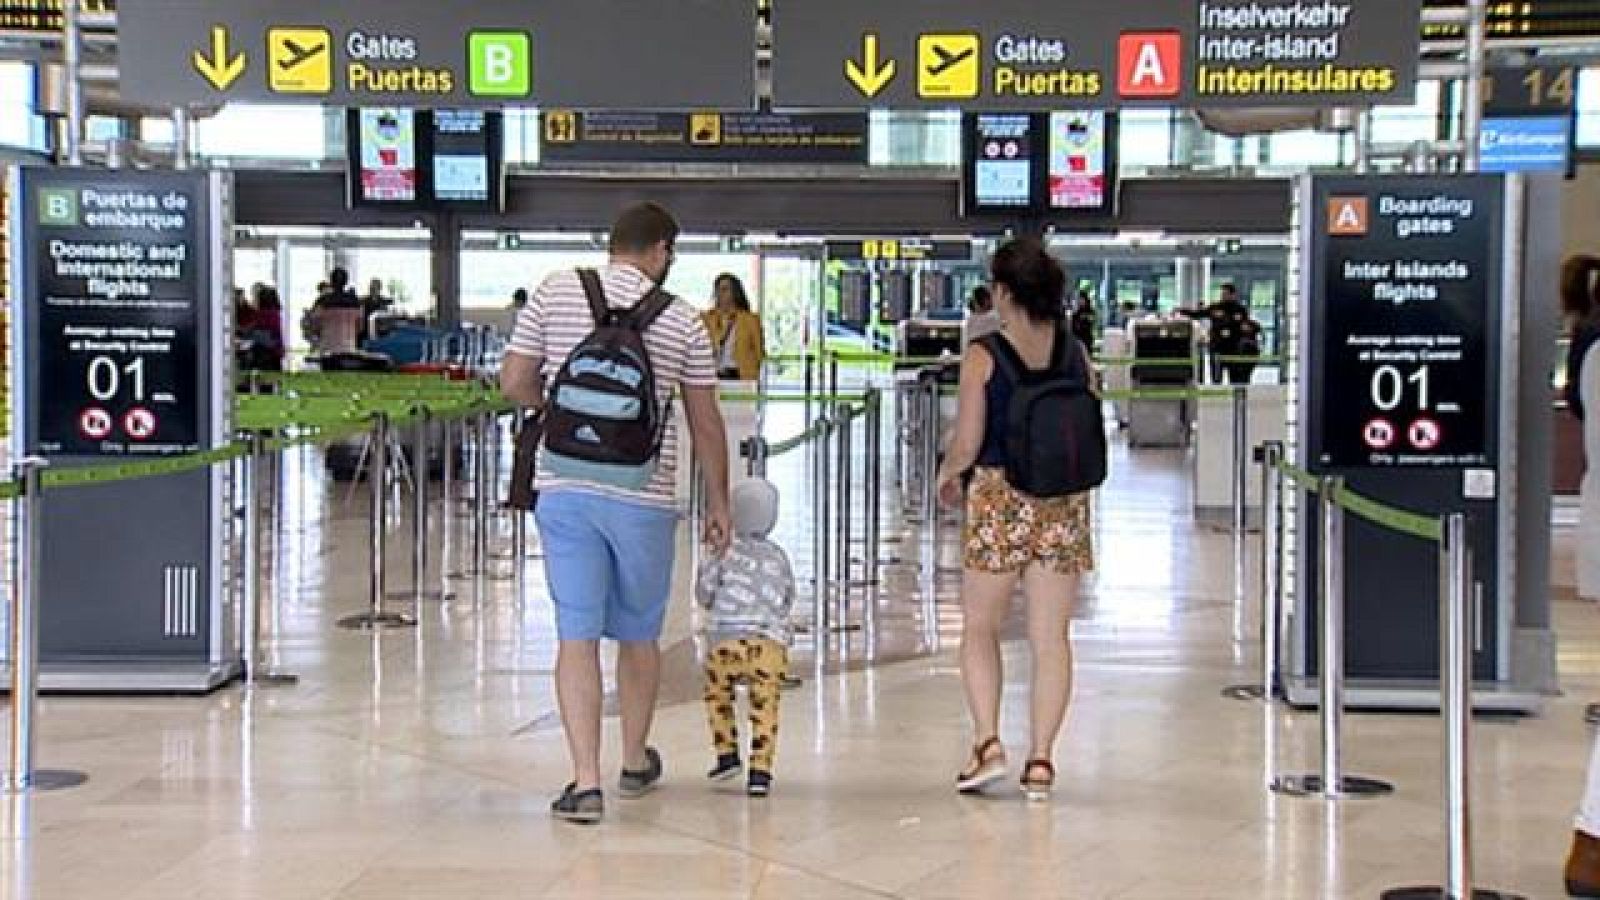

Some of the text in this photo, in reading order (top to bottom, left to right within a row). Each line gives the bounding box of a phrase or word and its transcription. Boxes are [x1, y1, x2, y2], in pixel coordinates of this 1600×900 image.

[1199, 2, 1350, 28] Inselverkehr
[347, 31, 417, 60] Gates
[995, 35, 1065, 62] Gates
[1199, 33, 1338, 60] Inter-island
[484, 44, 513, 82] B
[1130, 42, 1165, 86] A
[348, 65, 453, 93] Puertas
[995, 67, 1101, 95] Puertas
[1199, 64, 1395, 94] Interinsulares
[1521, 69, 1574, 105] 14
[48, 196, 69, 219] B
[82, 189, 188, 209] Puertas de
[1379, 195, 1473, 218] Boarding
[85, 210, 185, 231] embarque
[1336, 202, 1360, 227] A
[1397, 218, 1453, 238] gates
[51, 240, 186, 260] Domestic and
[1344, 260, 1391, 279] Inter
[88, 279, 150, 299] flights
[1374, 282, 1438, 304] flights
[87, 355, 145, 401] 01
[1371, 365, 1429, 410] 01
